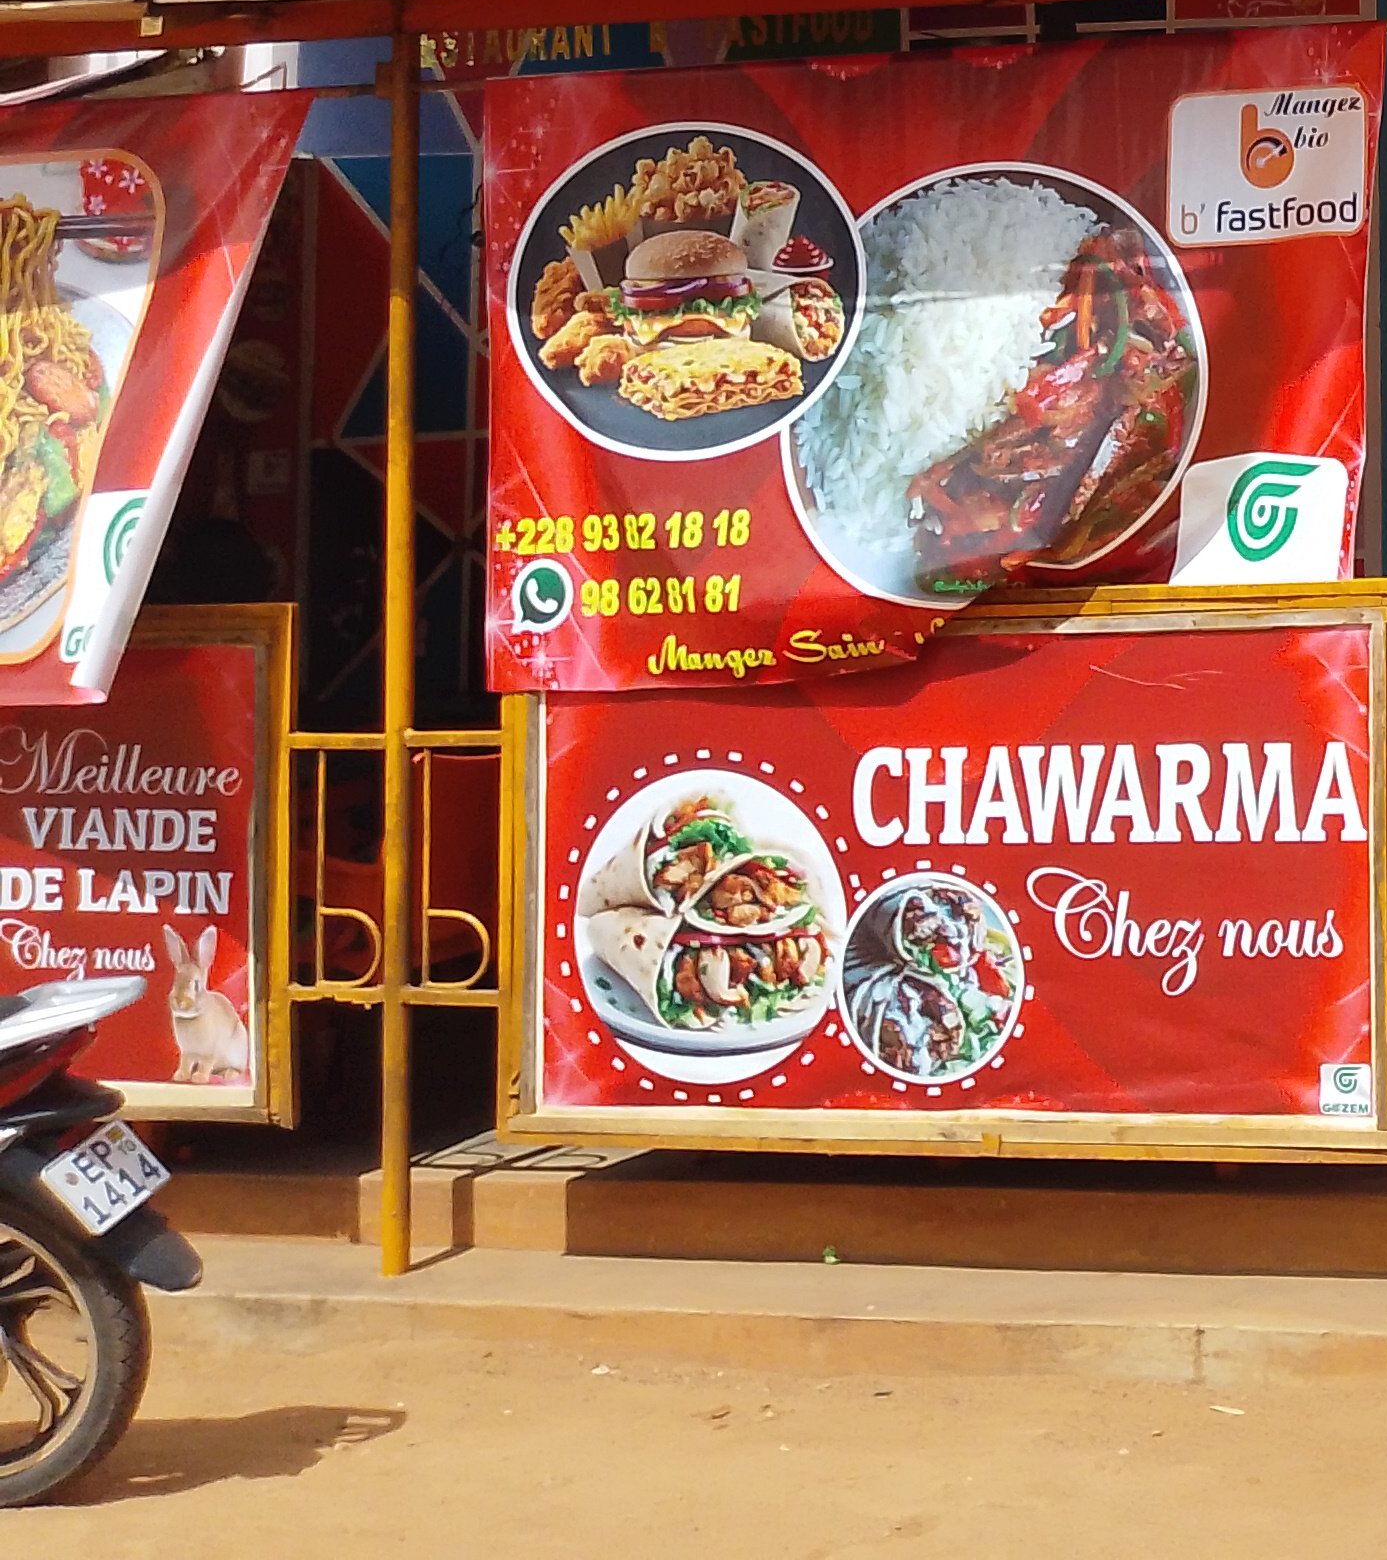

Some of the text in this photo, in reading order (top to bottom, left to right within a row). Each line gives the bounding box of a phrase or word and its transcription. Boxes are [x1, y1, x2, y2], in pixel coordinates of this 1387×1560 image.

[1263, 91, 1363, 119] Mangez
[1292, 125, 1329, 150] bio
[1216, 192, 1359, 233] fastfood
[495, 508, 752, 556] +228 93 82 18 18
[579, 573, 742, 616] 98 62 81 81
[0, 724, 244, 797] Meilleure
[851, 741, 1369, 848] CHAWARMA
[22, 806, 218, 853] VIANDE
[0, 866, 235, 915] DE LAPIN
[0, 917, 156, 981] Chez nous
[1025, 866, 1345, 997] Chez nous
[70, 1140, 114, 1184] EP
[82, 1152, 162, 1226] 1414
